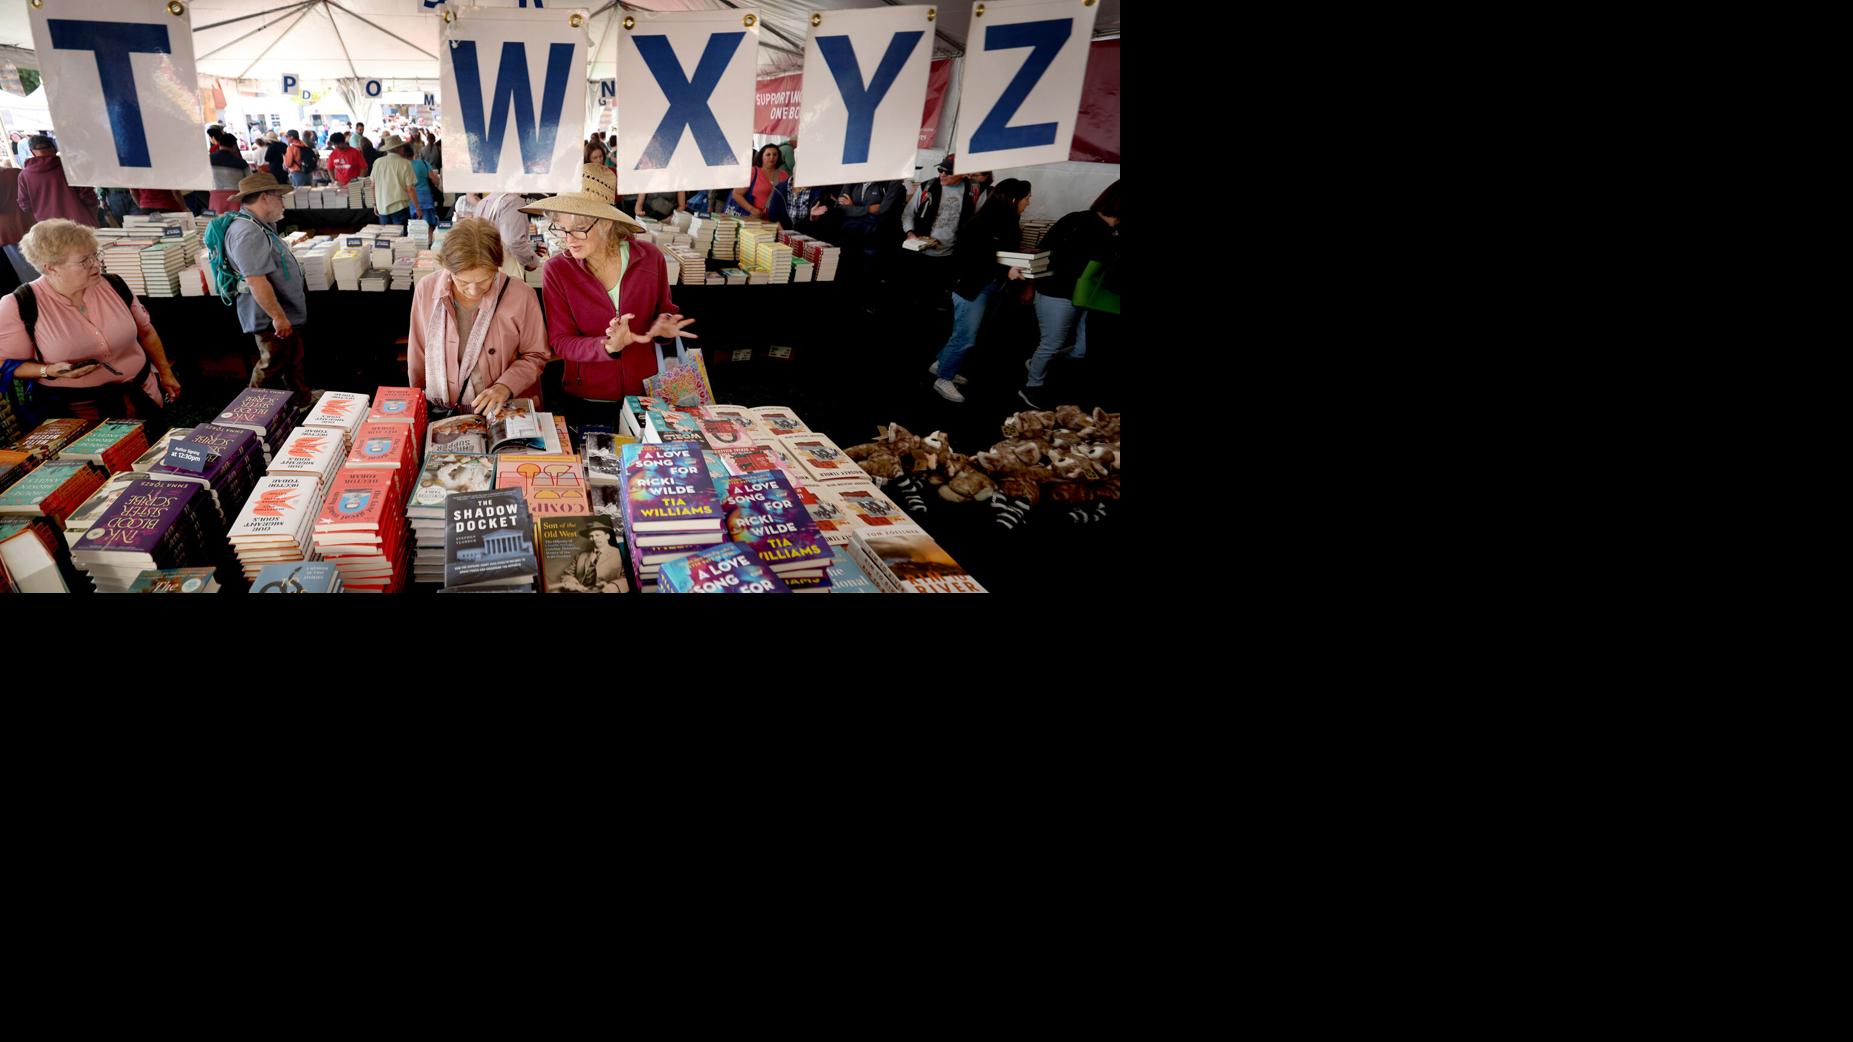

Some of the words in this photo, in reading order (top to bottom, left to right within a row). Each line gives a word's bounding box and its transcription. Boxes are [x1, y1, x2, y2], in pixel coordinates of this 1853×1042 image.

[283, 76, 297, 95] P
[366, 79, 382, 98] O
[602, 80, 615, 98] N
[969, 18, 1074, 154] Z
[47, 19, 171, 168] T
[303, 90, 311, 100] D
[424, 94, 434, 106] M
[815, 31, 925, 165] Y
[449, 40, 575, 174] W
[631, 31, 747, 171] X
[770, 106, 788, 120] ONE
[178, 452, 201, 462] 12:30pm
[656, 450, 691, 459] LOVE
[635, 459, 673, 467] SONG
[670, 466, 698, 475] FOR
[637, 477, 675, 487] RICKI
[745, 480, 780, 492] LOVE
[649, 486, 695, 495] WILDE
[125, 494, 177, 507] SCRIBE
[662, 498, 686, 507] TIA
[729, 493, 765, 504] SONG
[766, 500, 793, 510] FOR
[120, 505, 168, 518] SISTER
[454, 503, 518, 521] SHADOW
[641, 506, 713, 517] WILLIAMS
[108, 517, 160, 529] BLOOD
[456, 515, 518, 533] DOCKET
[737, 514, 774, 527] RICKI
[752, 522, 797, 535] WILDE
[105, 528, 138, 544] INK
[767, 539, 792, 548] TIA
[698, 570, 708, 580] A
[712, 557, 751, 575] LOVE
[904, 571, 947, 585] RIM
[152, 580, 178, 592] The
[695, 577, 739, 593] SONG
[740, 581, 775, 593] FOR
[915, 582, 980, 593] RIVER
